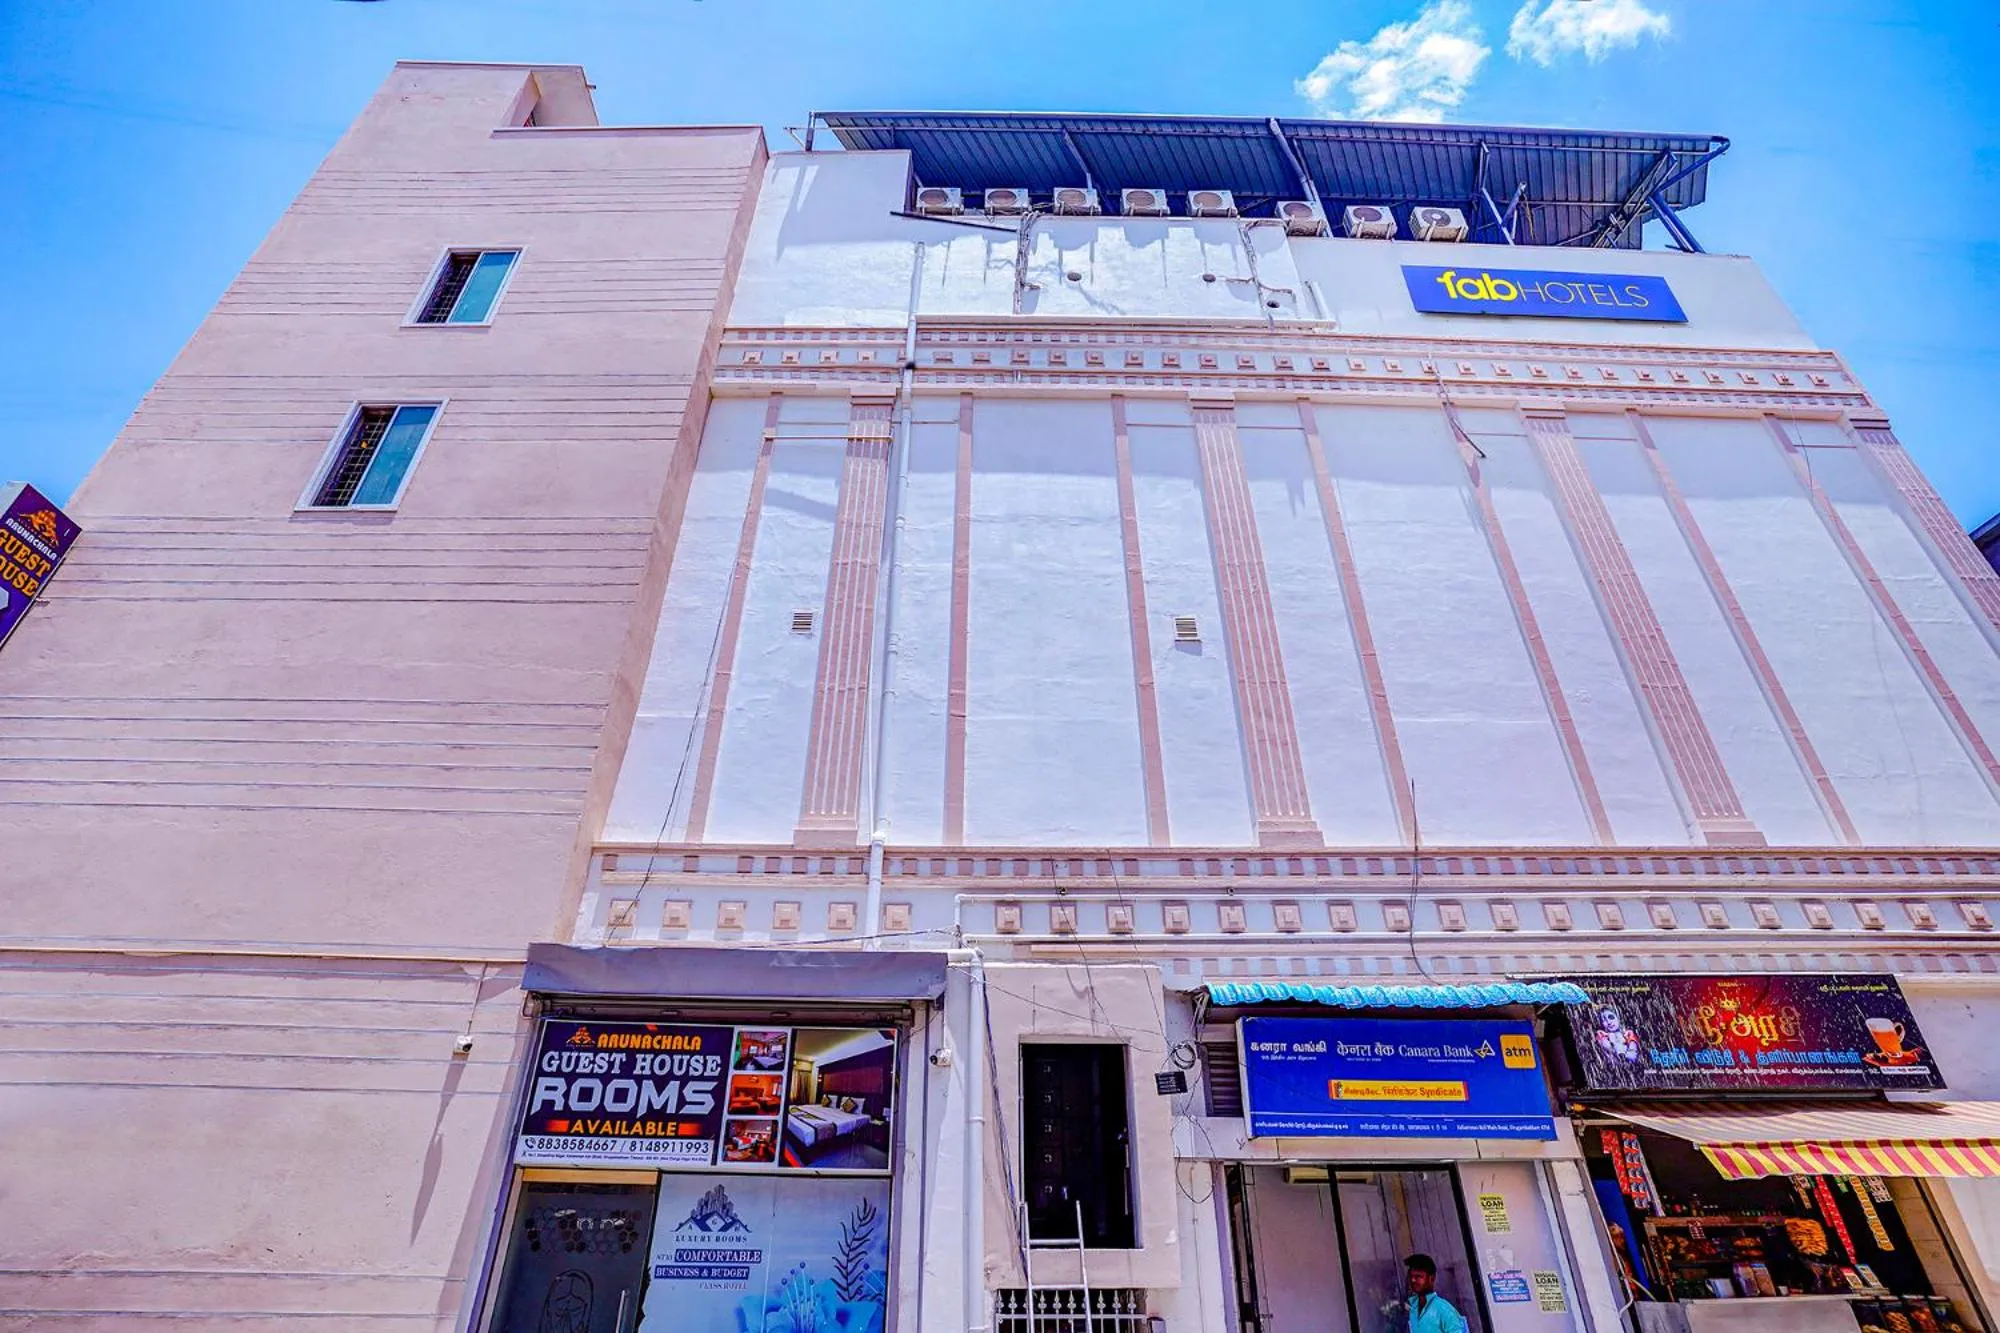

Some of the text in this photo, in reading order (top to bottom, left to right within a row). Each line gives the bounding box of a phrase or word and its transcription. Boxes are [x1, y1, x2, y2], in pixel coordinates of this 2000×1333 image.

[1436, 270, 1650, 308] fabHOTELS
[597, 1034, 702, 1051] ARUNACHALA
[1250, 1041, 1327, 1057] கனரா வங்கி
[1337, 1041, 1371, 1056] केनरा
[1398, 1044, 1474, 1058] Canara Bank
[1505, 1045, 1532, 1058] atm
[1740, 1050, 1751, 1064] &
[541, 1050, 722, 1077] GUEST HOUSE
[530, 1076, 720, 1119] ROOMS
[1419, 1087, 1462, 1098] Syndicate
[570, 1119, 677, 1137] AVAILABLE
[537, 1137, 618, 1152] 8838584667
[629, 1141, 709, 1154] 8148911993
[675, 1235, 748, 1244] LUXURY ROOMS
[676, 1250, 761, 1262] COMFORTABLE
[656, 1267, 748, 1278] BUSINESS & BUDGET
[1536, 1277, 1560, 1285] LOAN
